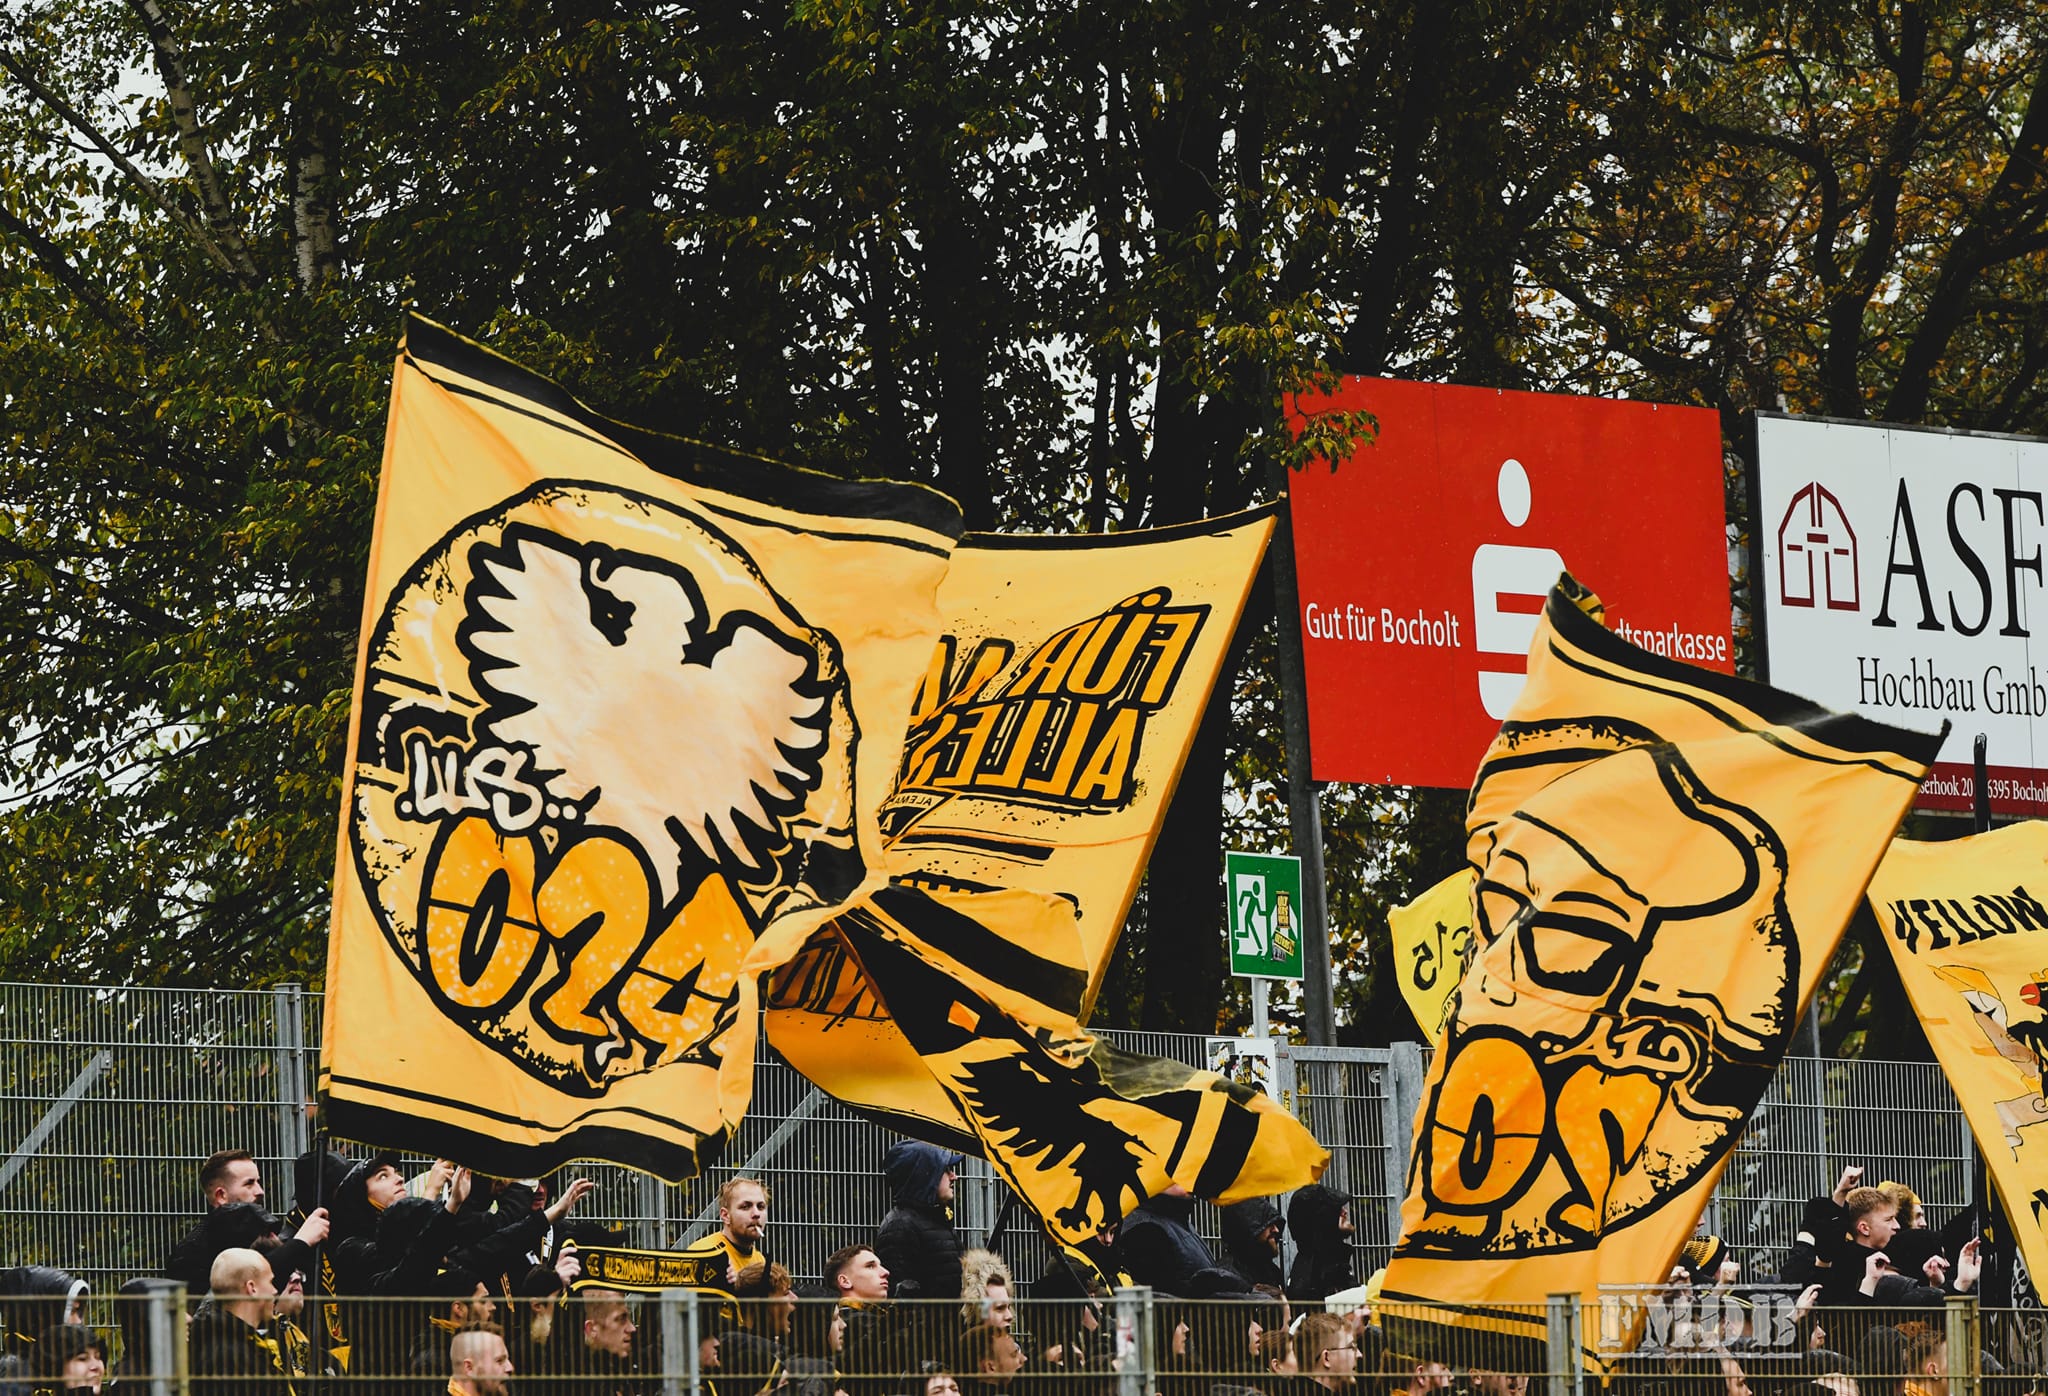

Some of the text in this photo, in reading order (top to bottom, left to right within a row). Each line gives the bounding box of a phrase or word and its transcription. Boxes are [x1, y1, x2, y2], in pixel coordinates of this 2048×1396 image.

[1872, 477, 2044, 638] ASF
[1306, 602, 1461, 648] Gut für Bocholt
[1612, 618, 1727, 661] dtsparkasse
[1857, 656, 2048, 717] Hochbau Gmb
[1918, 773, 1960, 796] serhook
[1961, 777, 1974, 797] 20
[1986, 779, 2011, 800] 6395
[1887, 885, 2048, 955] YELLOW
